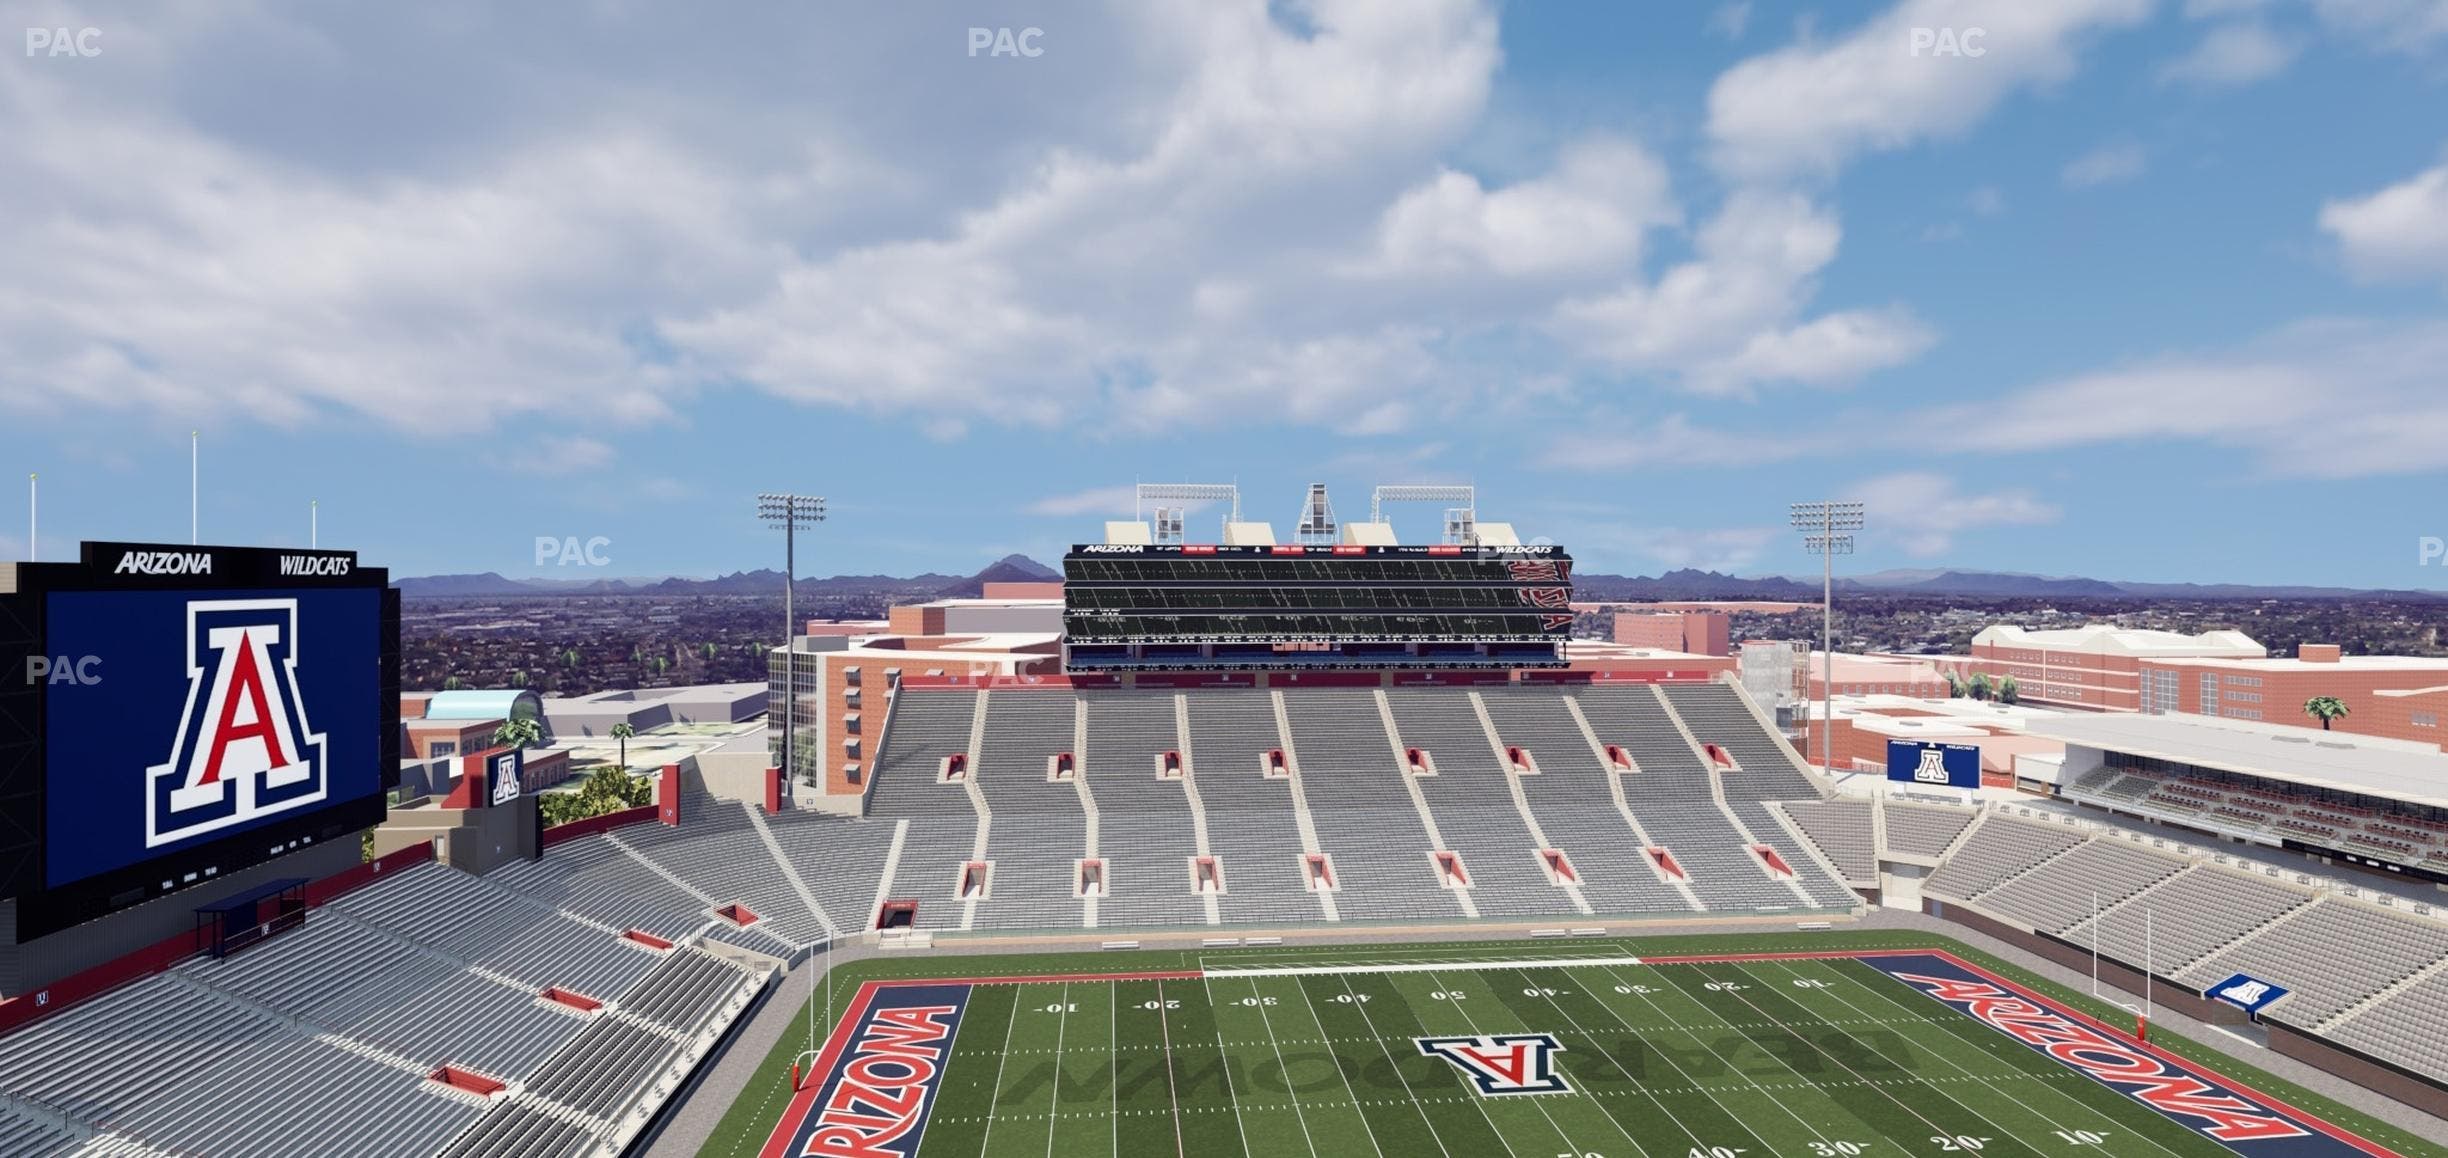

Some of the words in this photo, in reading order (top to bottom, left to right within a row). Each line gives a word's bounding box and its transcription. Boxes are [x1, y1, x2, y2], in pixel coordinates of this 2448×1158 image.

[115, 551, 212, 574] ARIZONA
[280, 555, 351, 576] WILDCATS
[1083, 545, 1144, 554] ARIZONA
[1496, 546, 1553, 554] WILDCATS
[146, 598, 327, 849] A
[493, 754, 520, 806] A
[1914, 749, 1949, 785] A
[799, 1005, 958, 1158] RIZONA
[1003, 1051, 1459, 1106] DOWN
[1411, 1032, 1577, 1097] A
[1562, 1030, 1919, 1083] BEAR
[1889, 972, 2313, 1142] ARIZONA
[1807, 1140, 1861, 1158] 30
[1929, 1135, 1984, 1152] 20
[2050, 1130, 2104, 1145] 10
